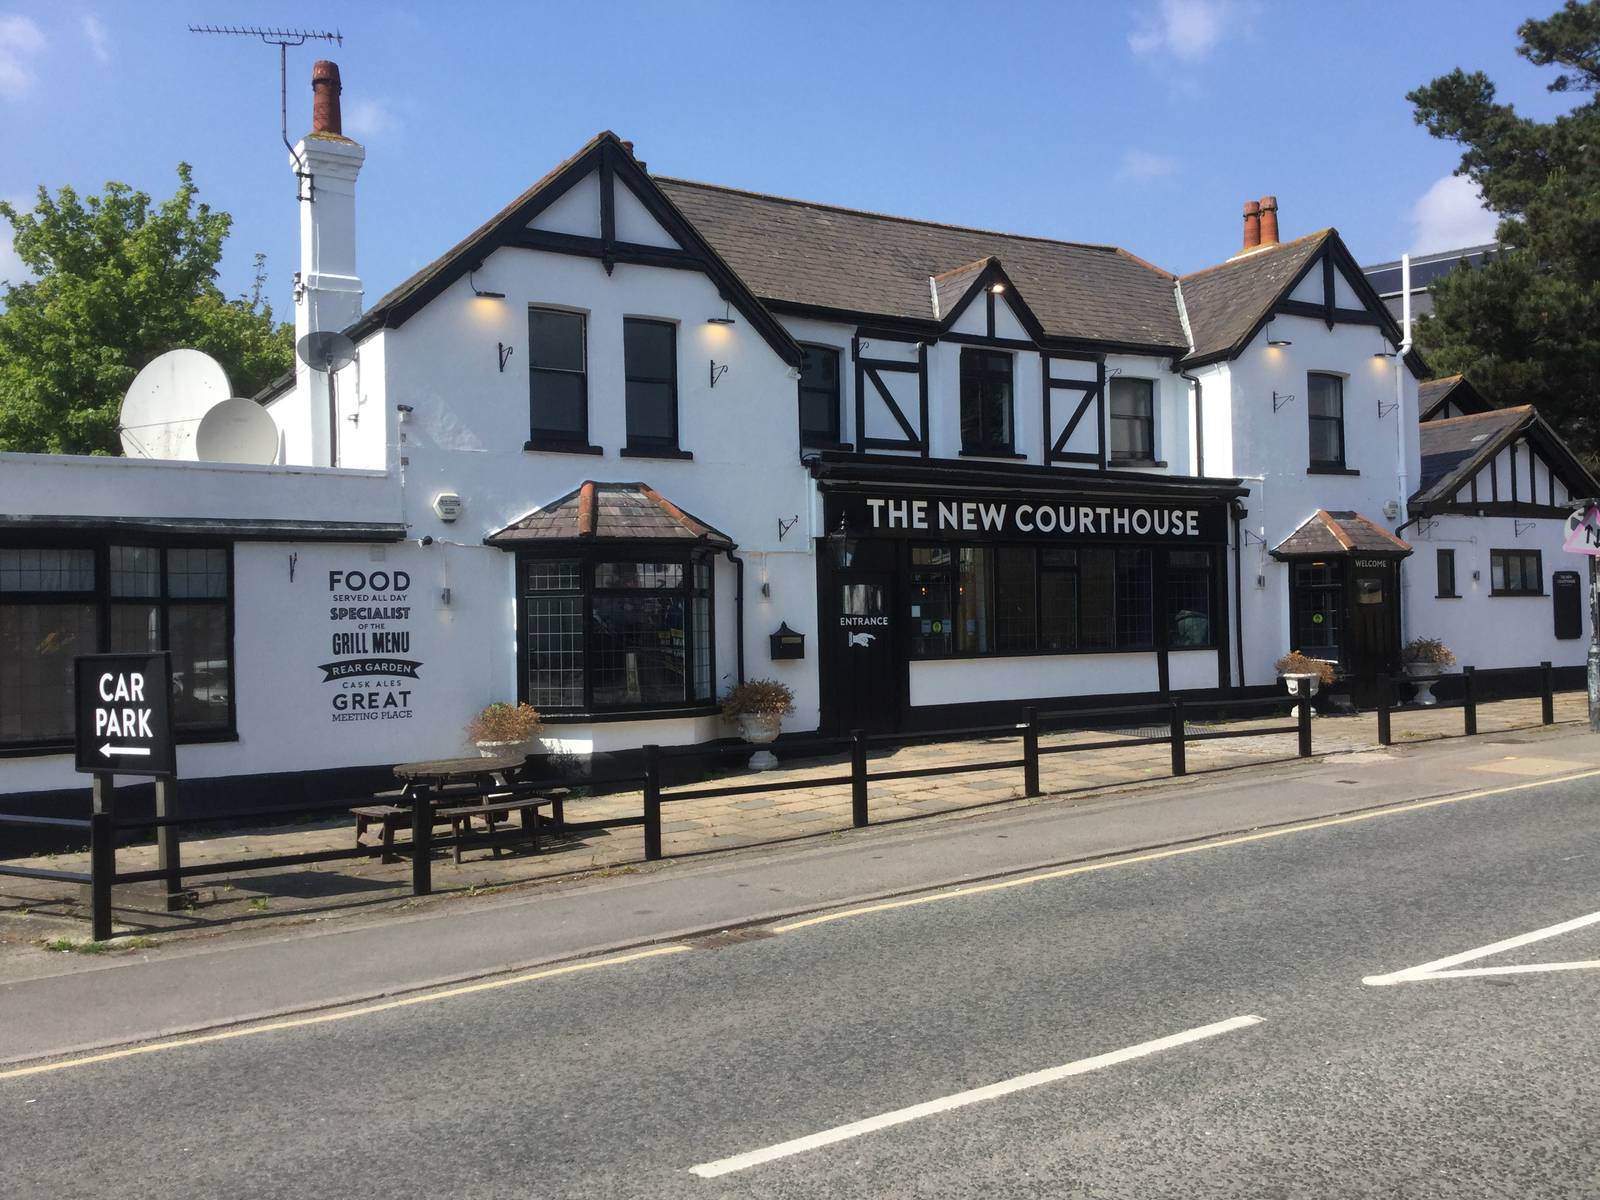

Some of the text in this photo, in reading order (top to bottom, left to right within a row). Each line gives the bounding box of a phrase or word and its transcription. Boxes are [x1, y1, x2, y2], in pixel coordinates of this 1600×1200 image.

[866, 498, 1200, 536] THE NEW COURTHOUSE
[1355, 559, 1387, 568] WELCOME
[329, 570, 411, 592] FOOD
[332, 594, 407, 602] SERVED ALL DAY
[330, 607, 411, 621] SPECIALIST
[840, 616, 889, 626] ENTRANCE
[332, 631, 410, 655] GRILL MENU
[332, 662, 411, 676] REAR GARDEN
[99, 672, 145, 702] CAR
[342, 681, 370, 689] CASK
[332, 690, 411, 711] GREAT
[95, 708, 154, 738] PARK
[332, 710, 413, 722] MEETING PLACE
